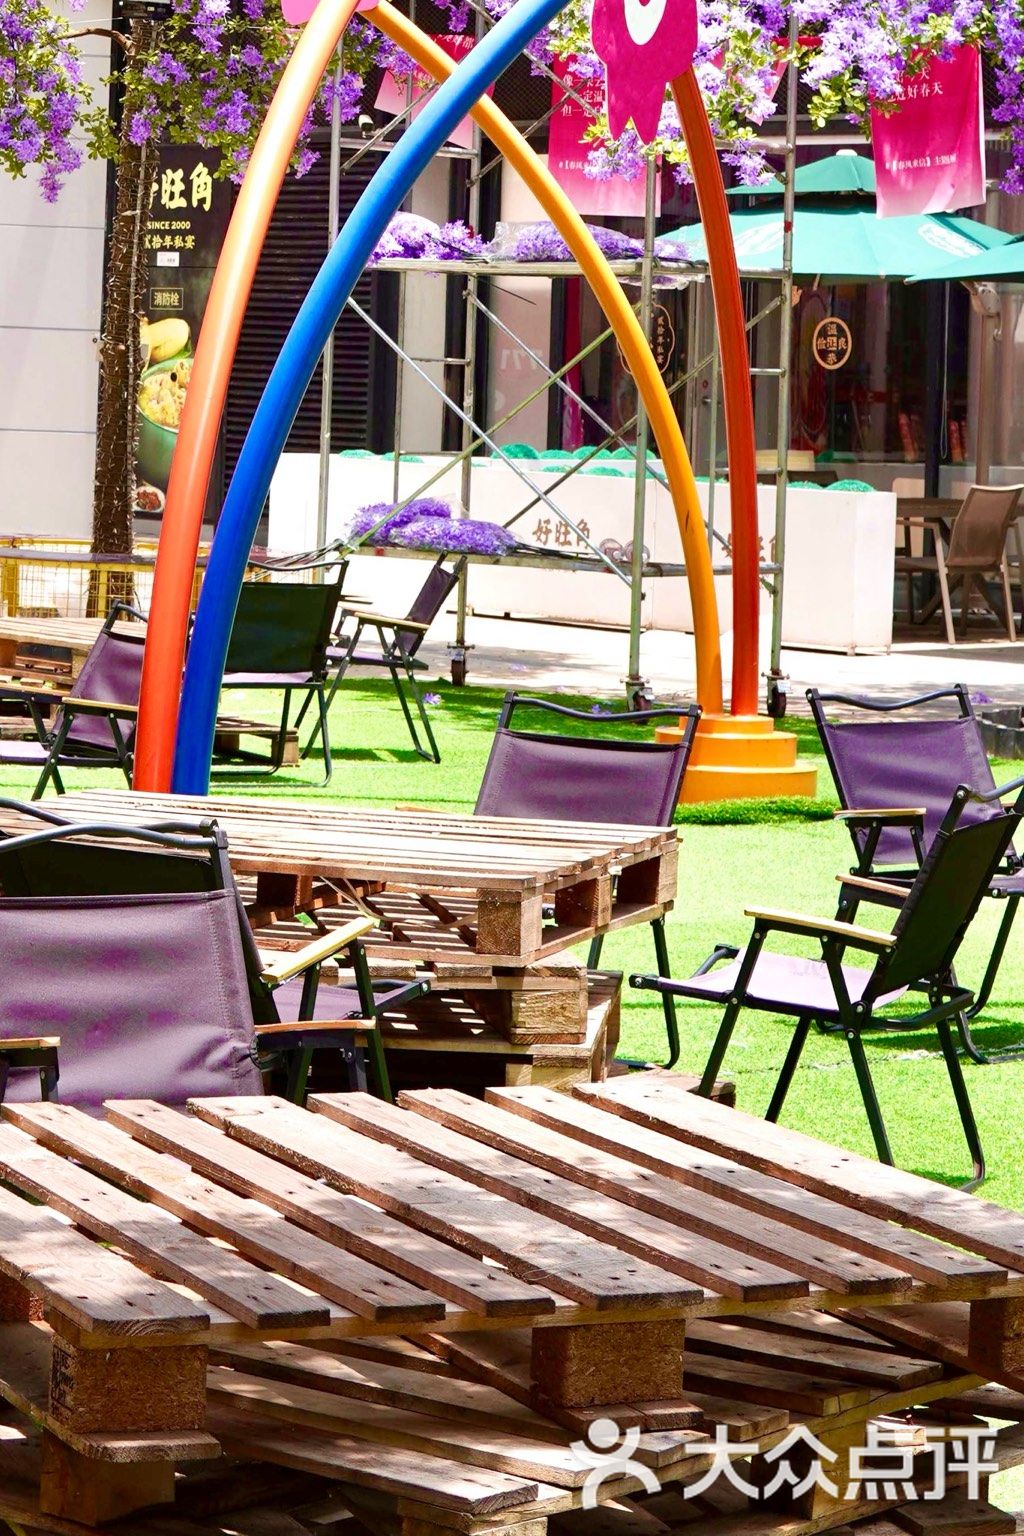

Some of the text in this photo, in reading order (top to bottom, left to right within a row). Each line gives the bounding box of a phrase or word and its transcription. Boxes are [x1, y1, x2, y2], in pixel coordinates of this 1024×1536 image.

[146, 221, 192, 230] SINCE 2000
[153, 292, 180, 306] 消防栓
